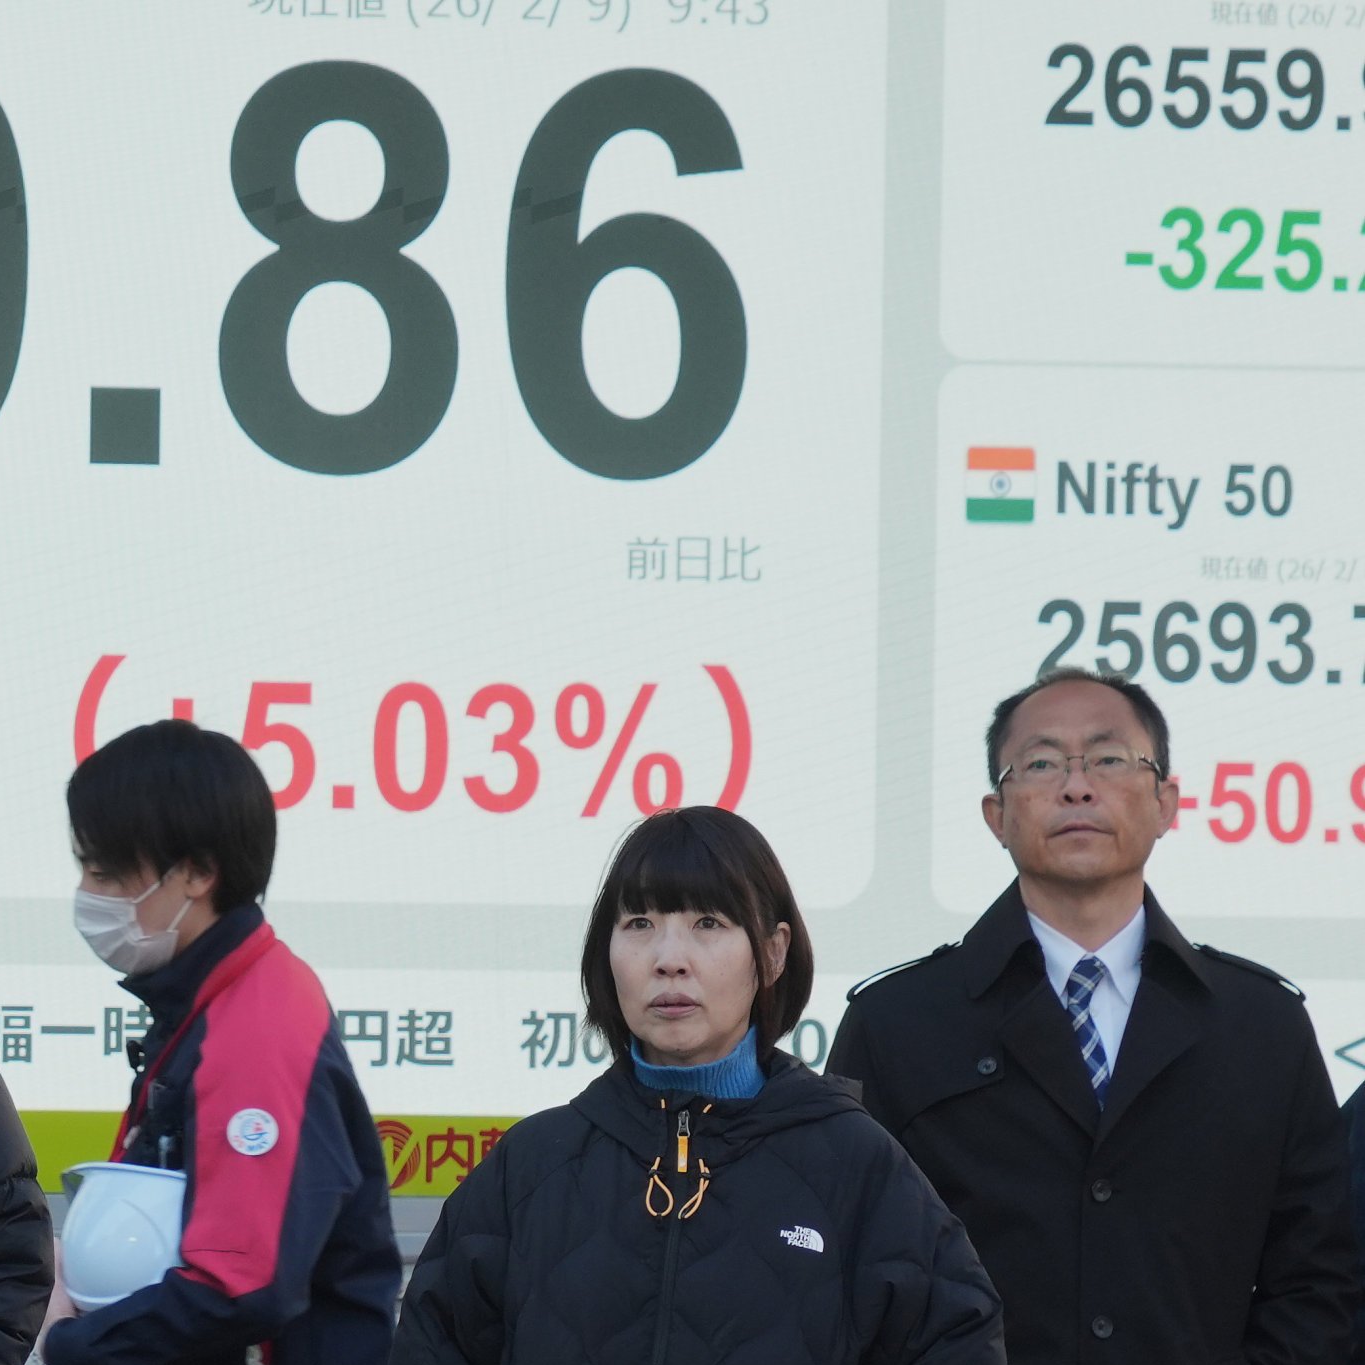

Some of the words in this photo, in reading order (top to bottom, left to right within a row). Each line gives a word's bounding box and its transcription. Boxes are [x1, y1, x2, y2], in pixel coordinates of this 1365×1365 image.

[1044, 43, 1365, 131] 26559.
[1125, 206, 1365, 292] -325.
[1056, 461, 1200, 530] Nifty
[1224, 464, 1293, 518] 50
[626, 536, 761, 582] 前日比
[1035, 599, 1365, 685] 25693.
[74, 654, 752, 818] (5.03%)
[426, 1127, 508, 1183] 内
[780, 1230, 810, 1242] NORTH
[787, 1238, 811, 1248] FACE
[794, 1225, 811, 1235] THE
